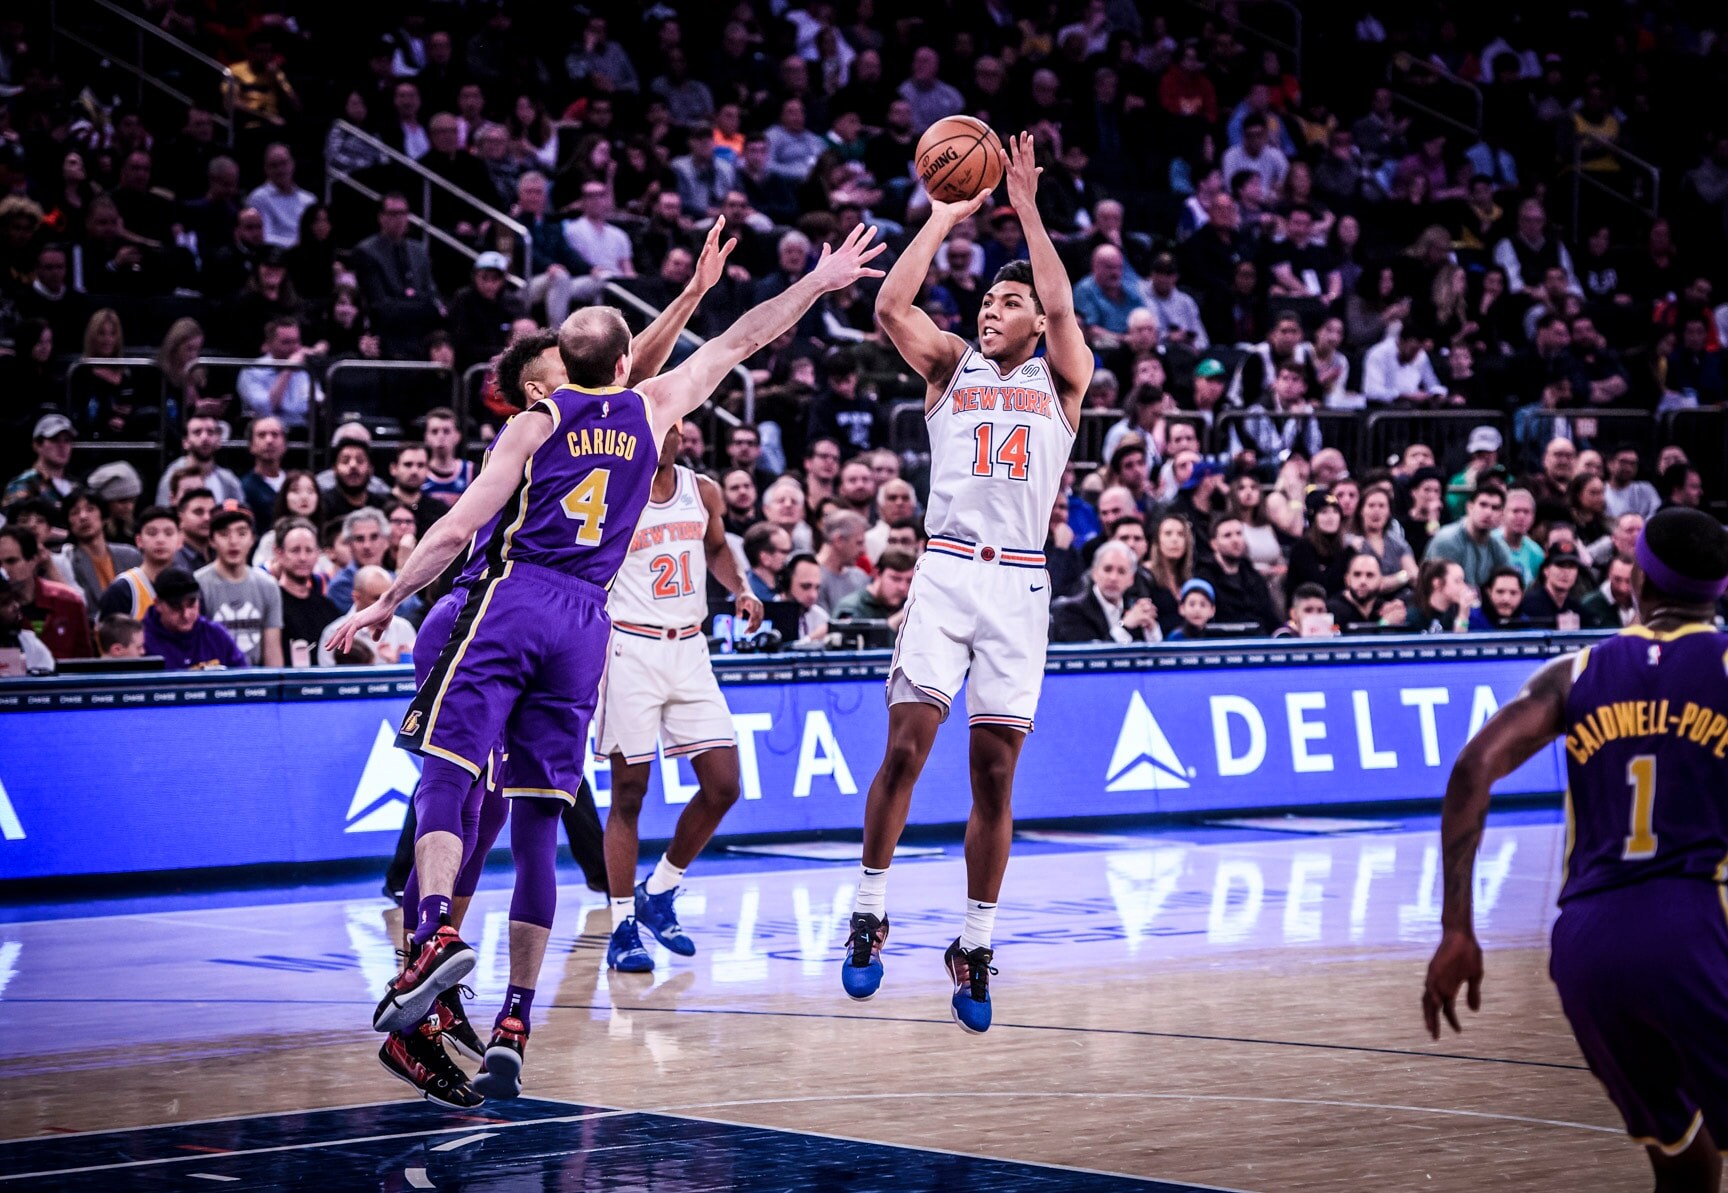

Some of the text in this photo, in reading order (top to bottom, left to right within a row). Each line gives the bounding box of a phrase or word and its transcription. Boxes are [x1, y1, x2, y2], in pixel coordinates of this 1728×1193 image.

[952, 386, 1052, 419] NEW YORK
[566, 428, 637, 461] CARUSO
[972, 422, 1031, 481] 14
[560, 467, 611, 547] 4
[630, 521, 704, 553] NEW YORK
[650, 550, 695, 600] 21
[583, 710, 858, 808] ELTA
[1621, 754, 1658, 861] 1
